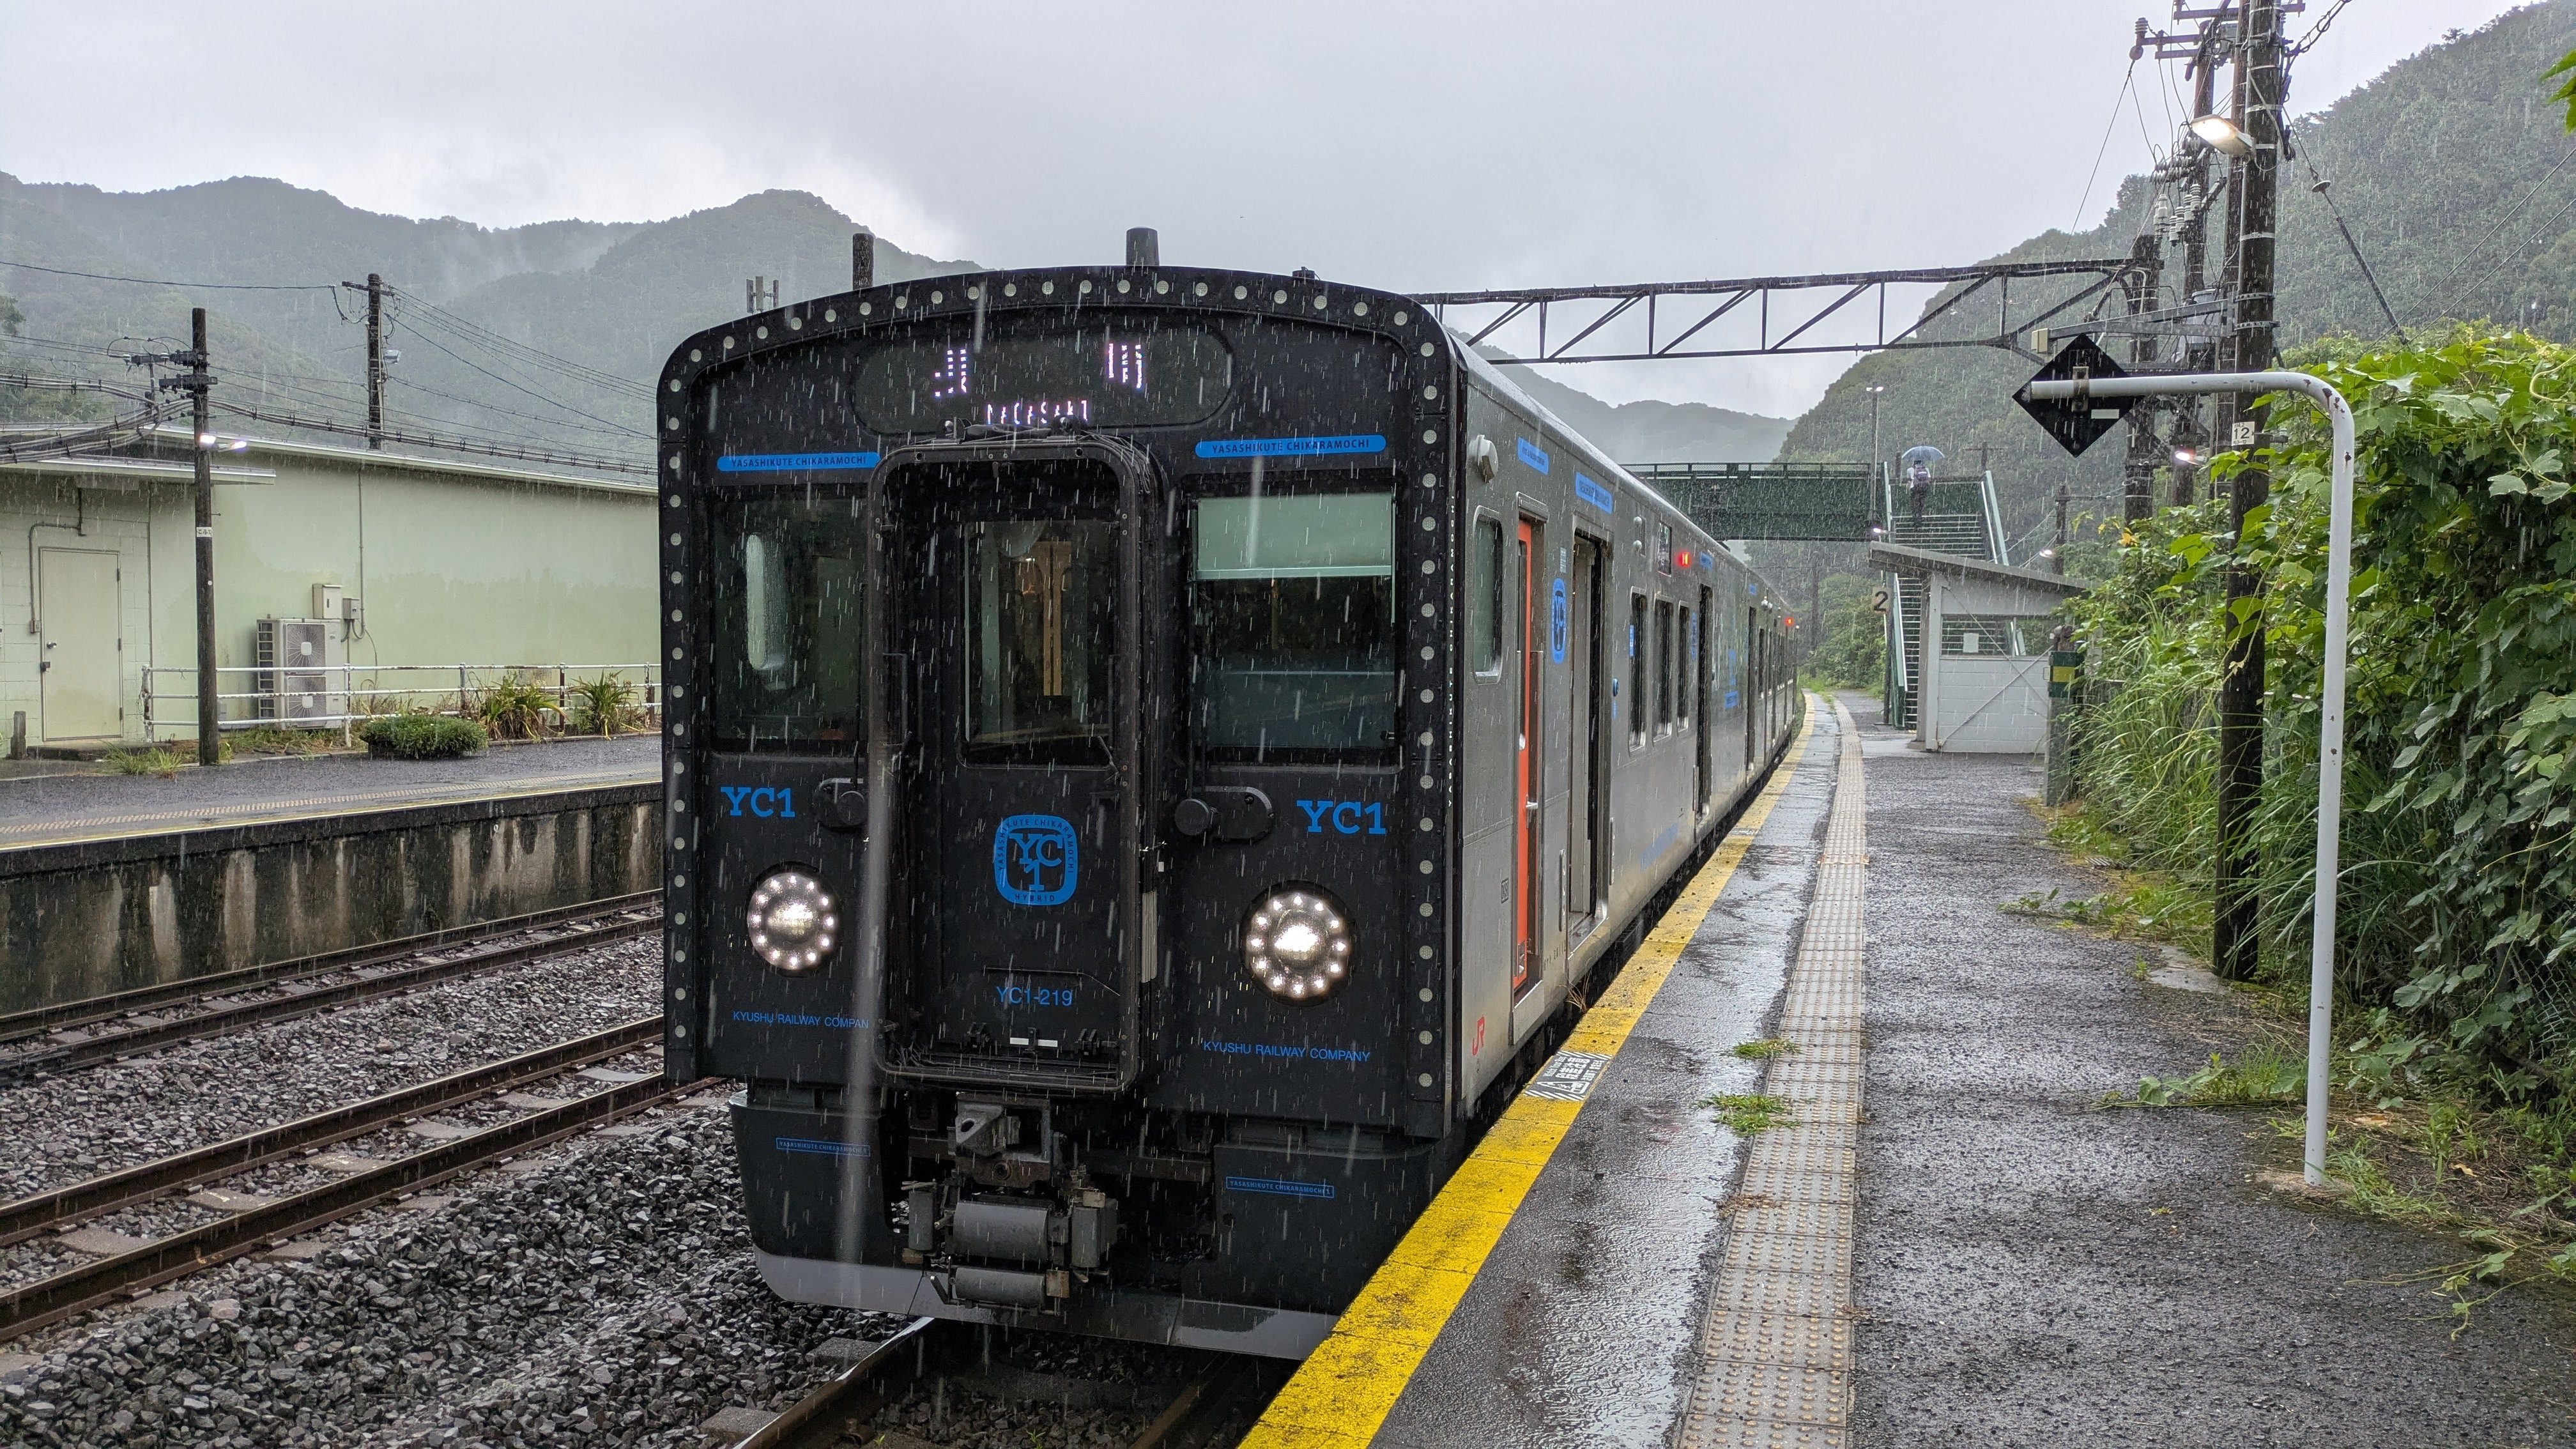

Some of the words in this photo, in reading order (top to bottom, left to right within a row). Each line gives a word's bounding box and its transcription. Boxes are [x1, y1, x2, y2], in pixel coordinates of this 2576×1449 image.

[2234, 427, 2250, 440] 12
[1214, 441, 1283, 454] YASASHIKUTE
[1286, 438, 1369, 451] CHIKARAMOCHI
[732, 458, 793, 468] YASASHIKUTE
[795, 456, 866, 466] CHIKARAMOCHI
[1874, 590, 1889, 611] 2
[720, 786, 796, 818] YC1
[1296, 800, 1386, 834] YC1
[997, 819, 1023, 871] YASASHIKUTE
[1034, 818, 1075, 873] CHIKARAMOCHI
[1015, 894, 1055, 902] HYBRID
[996, 986, 1073, 1006] YC1-219
[733, 1011, 774, 1023] KYUSHU
[777, 1013, 820, 1025] RAILWAY
[824, 1016, 869, 1029] COMPAN
[1472, 1016, 1485, 1056] JR
[1204, 1041, 1251, 1054] KYUSHU
[1255, 1045, 1306, 1057] RAILWAY
[1310, 1048, 1370, 1061] COMPANY
[1230, 1181, 1273, 1190] YASASHIKUTE
[1275, 1184, 1325, 1195] CHIKARAMOCHI
